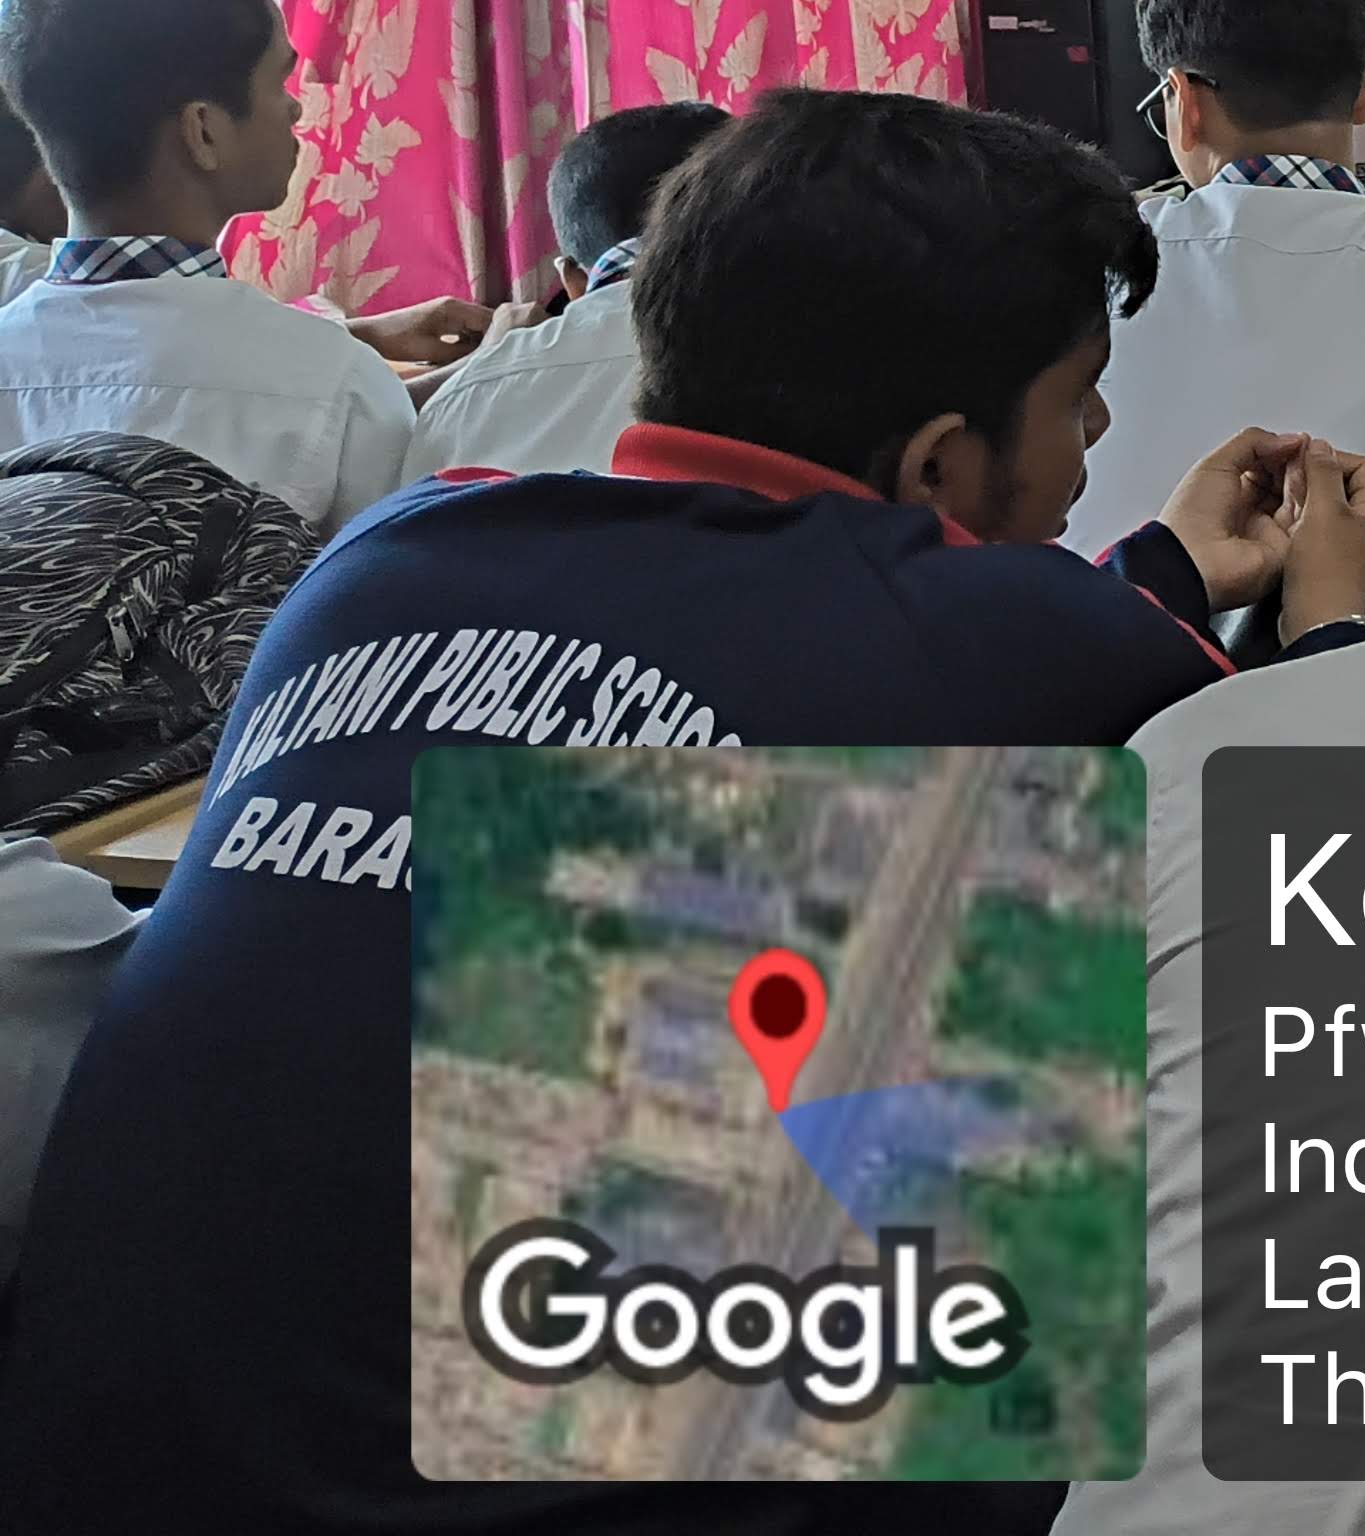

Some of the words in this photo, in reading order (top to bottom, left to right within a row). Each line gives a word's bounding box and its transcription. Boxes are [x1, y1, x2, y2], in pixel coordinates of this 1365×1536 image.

[208, 631, 439, 812] KALYANI
[390, 628, 602, 746] PUBLIC
[566, 655, 742, 747] SCH
[210, 796, 412, 892] BARA
